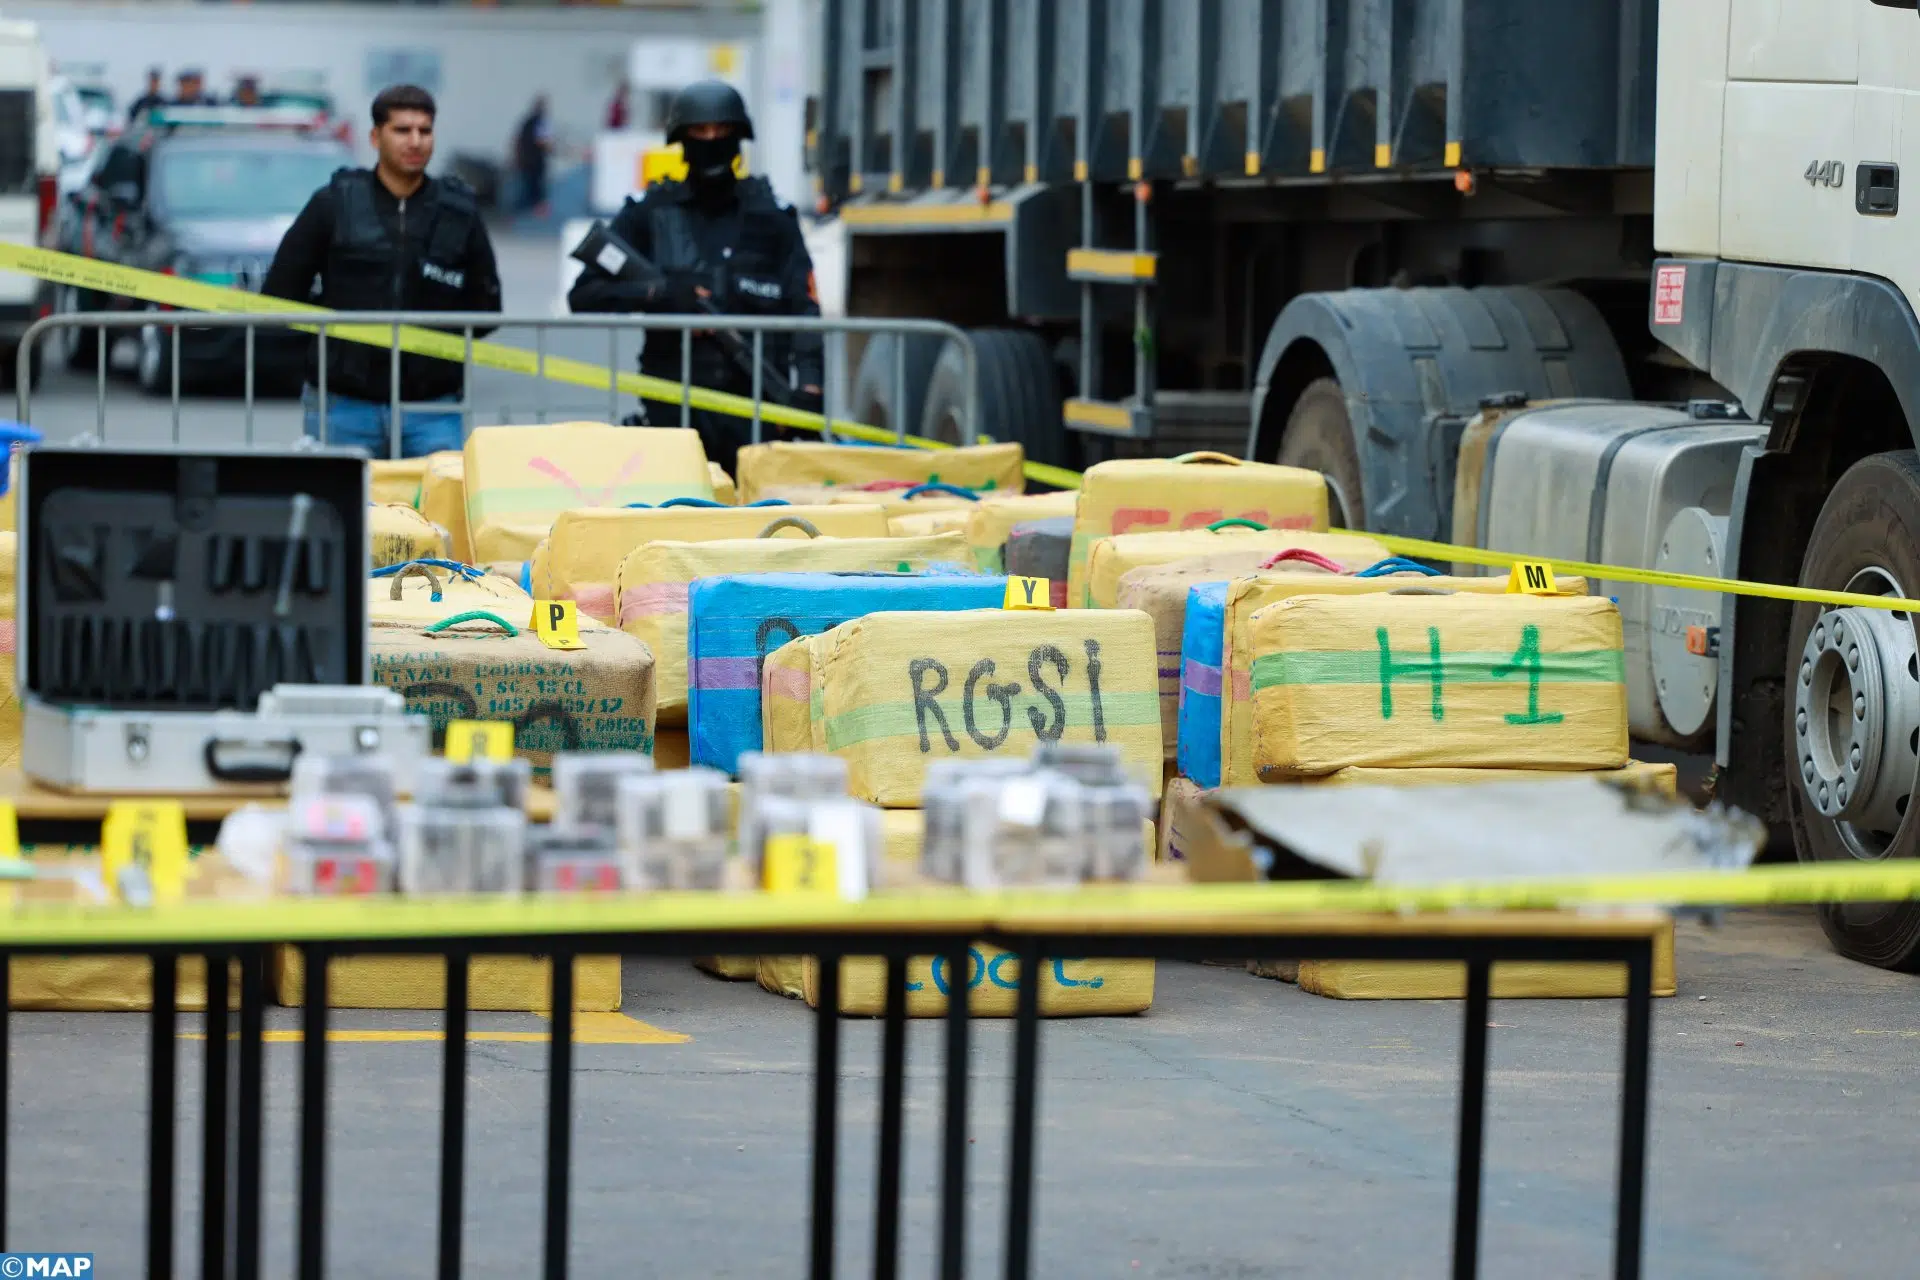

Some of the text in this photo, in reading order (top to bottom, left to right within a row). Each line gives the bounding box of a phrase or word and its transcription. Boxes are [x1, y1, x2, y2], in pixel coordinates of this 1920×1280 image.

[1804, 159, 1845, 188] 440
[1524, 565, 1548, 589] M
[1021, 579, 1038, 604] Y
[549, 603, 565, 632] P
